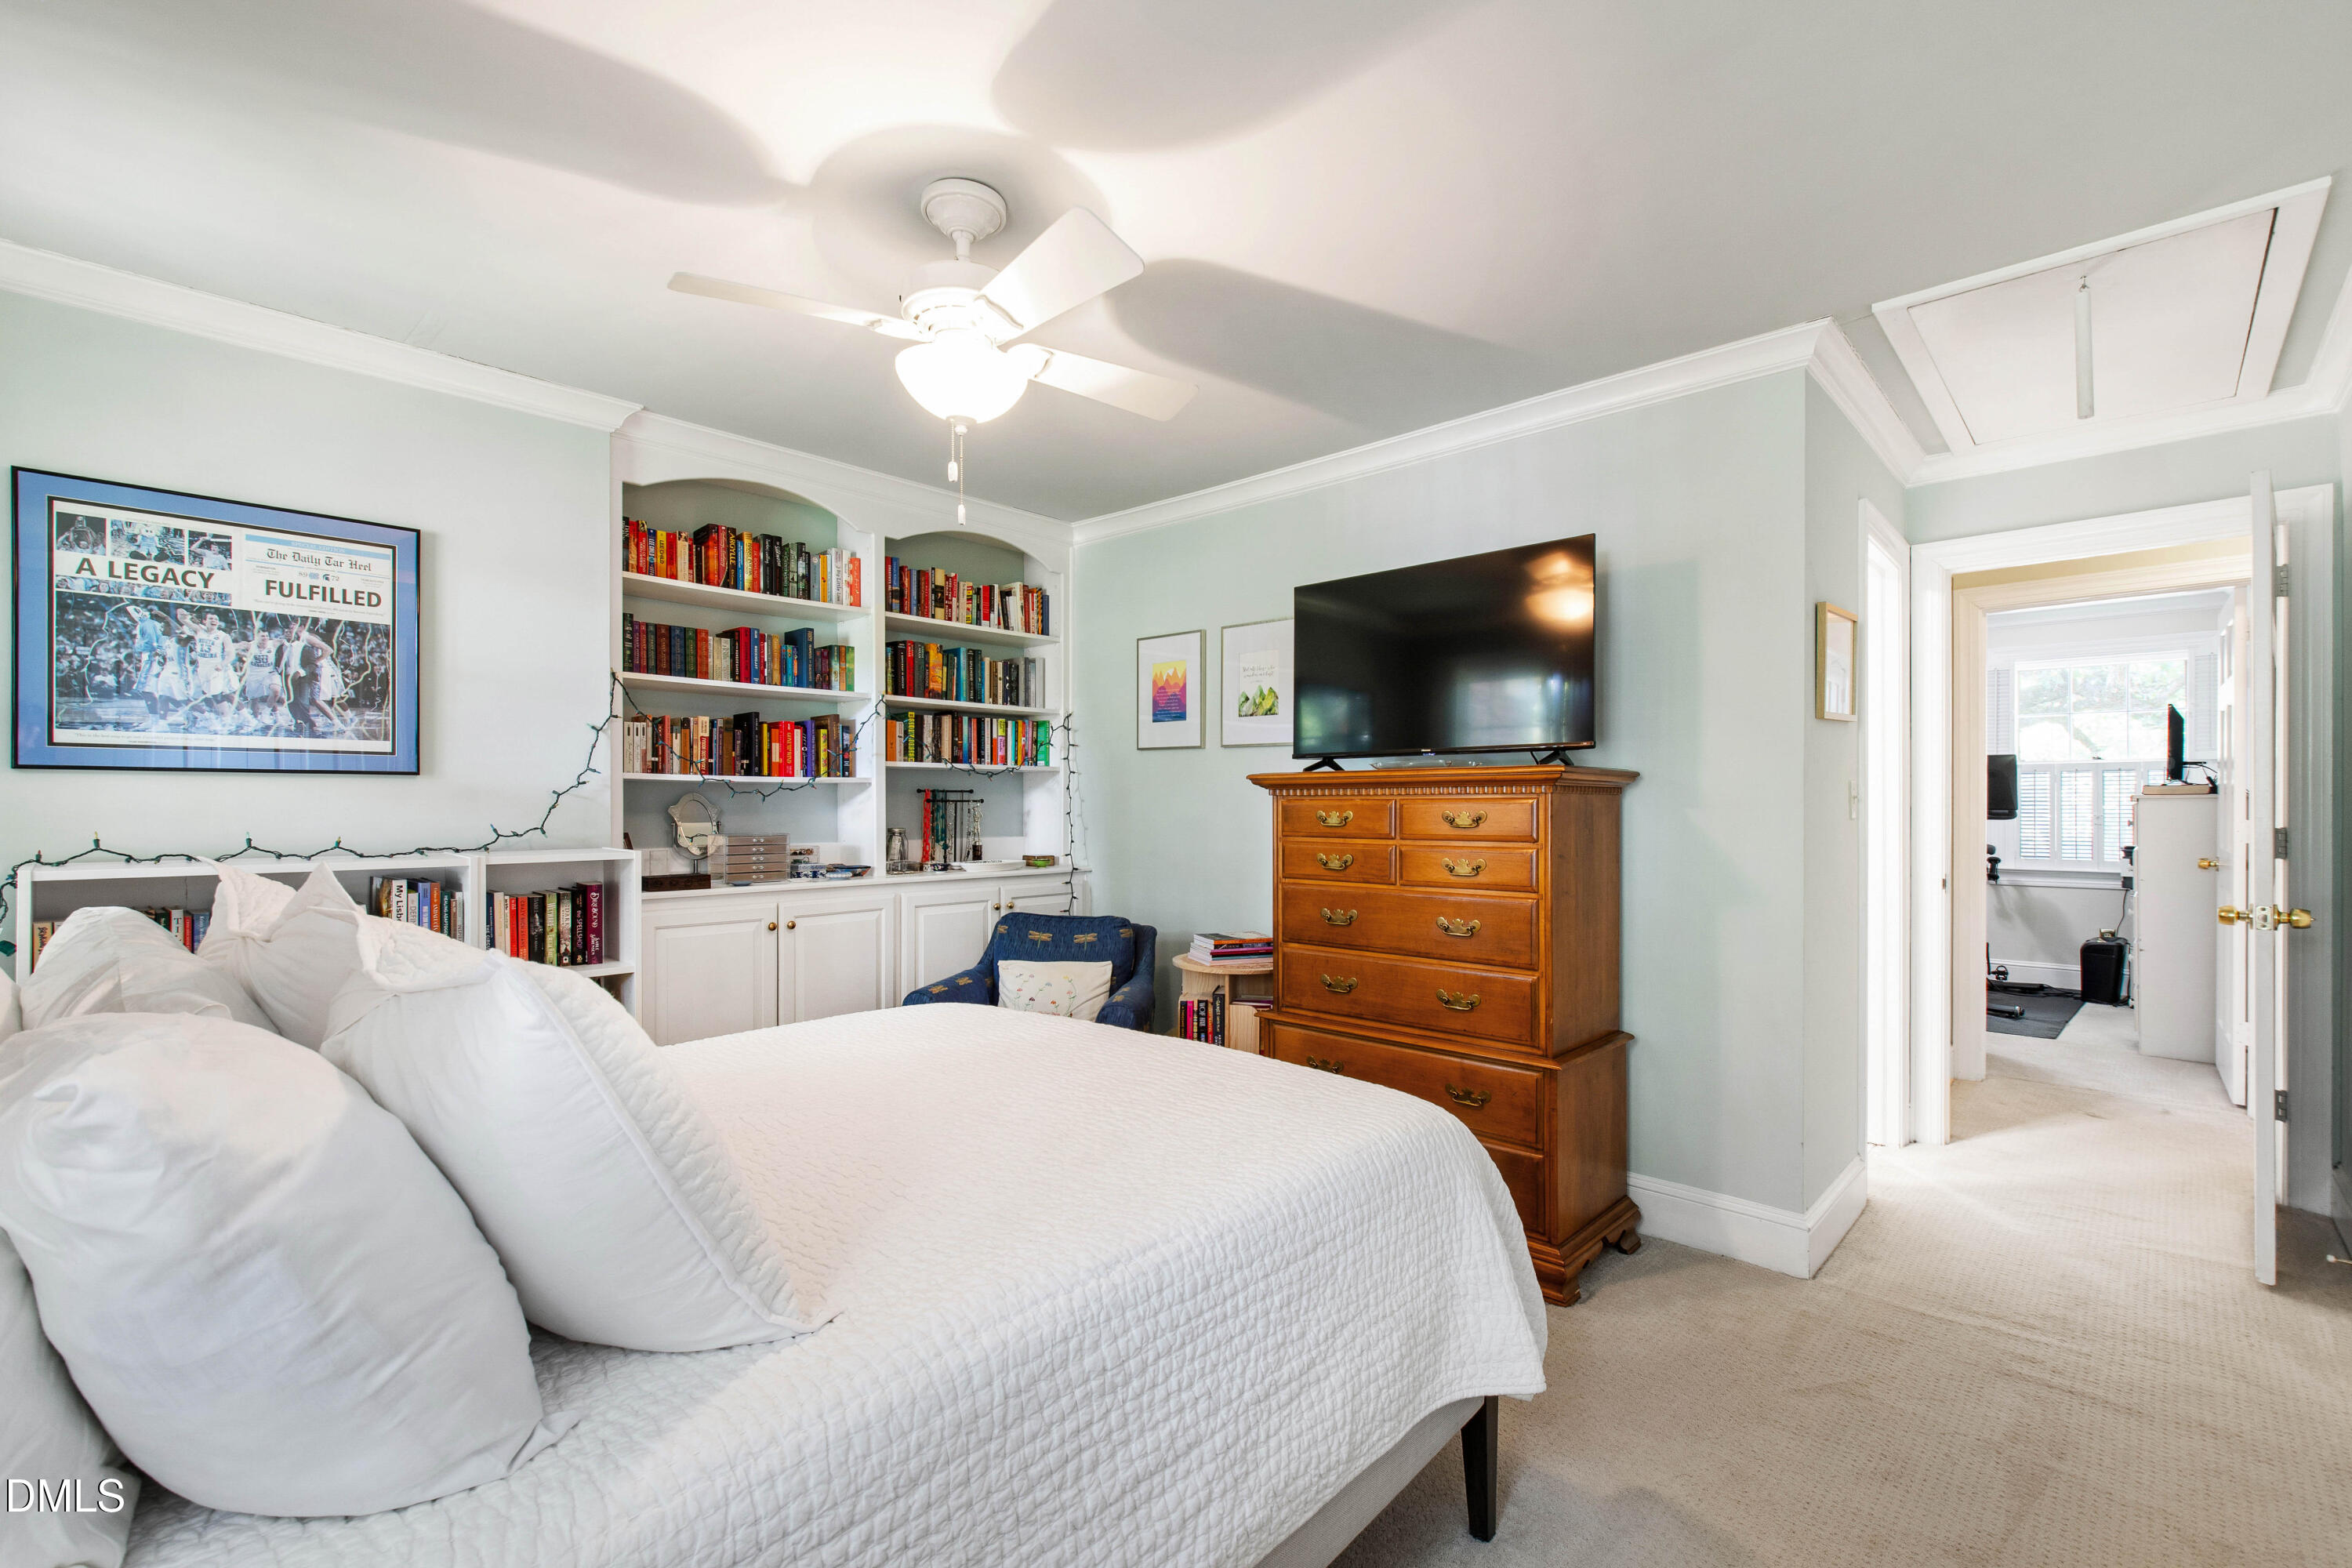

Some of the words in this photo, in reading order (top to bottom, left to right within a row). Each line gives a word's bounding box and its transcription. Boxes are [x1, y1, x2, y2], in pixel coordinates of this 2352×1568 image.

[266, 548, 289, 561] The
[292, 552, 321, 567] Daily
[325, 557, 345, 568] Tar
[348, 560, 372, 572] Heel
[75, 557, 97, 576] A
[107, 560, 215, 589] LEGACY
[265, 579, 383, 608] FULFILLED
[395, 885, 404, 898] My
[547, 902, 556, 927] WEYWARD
